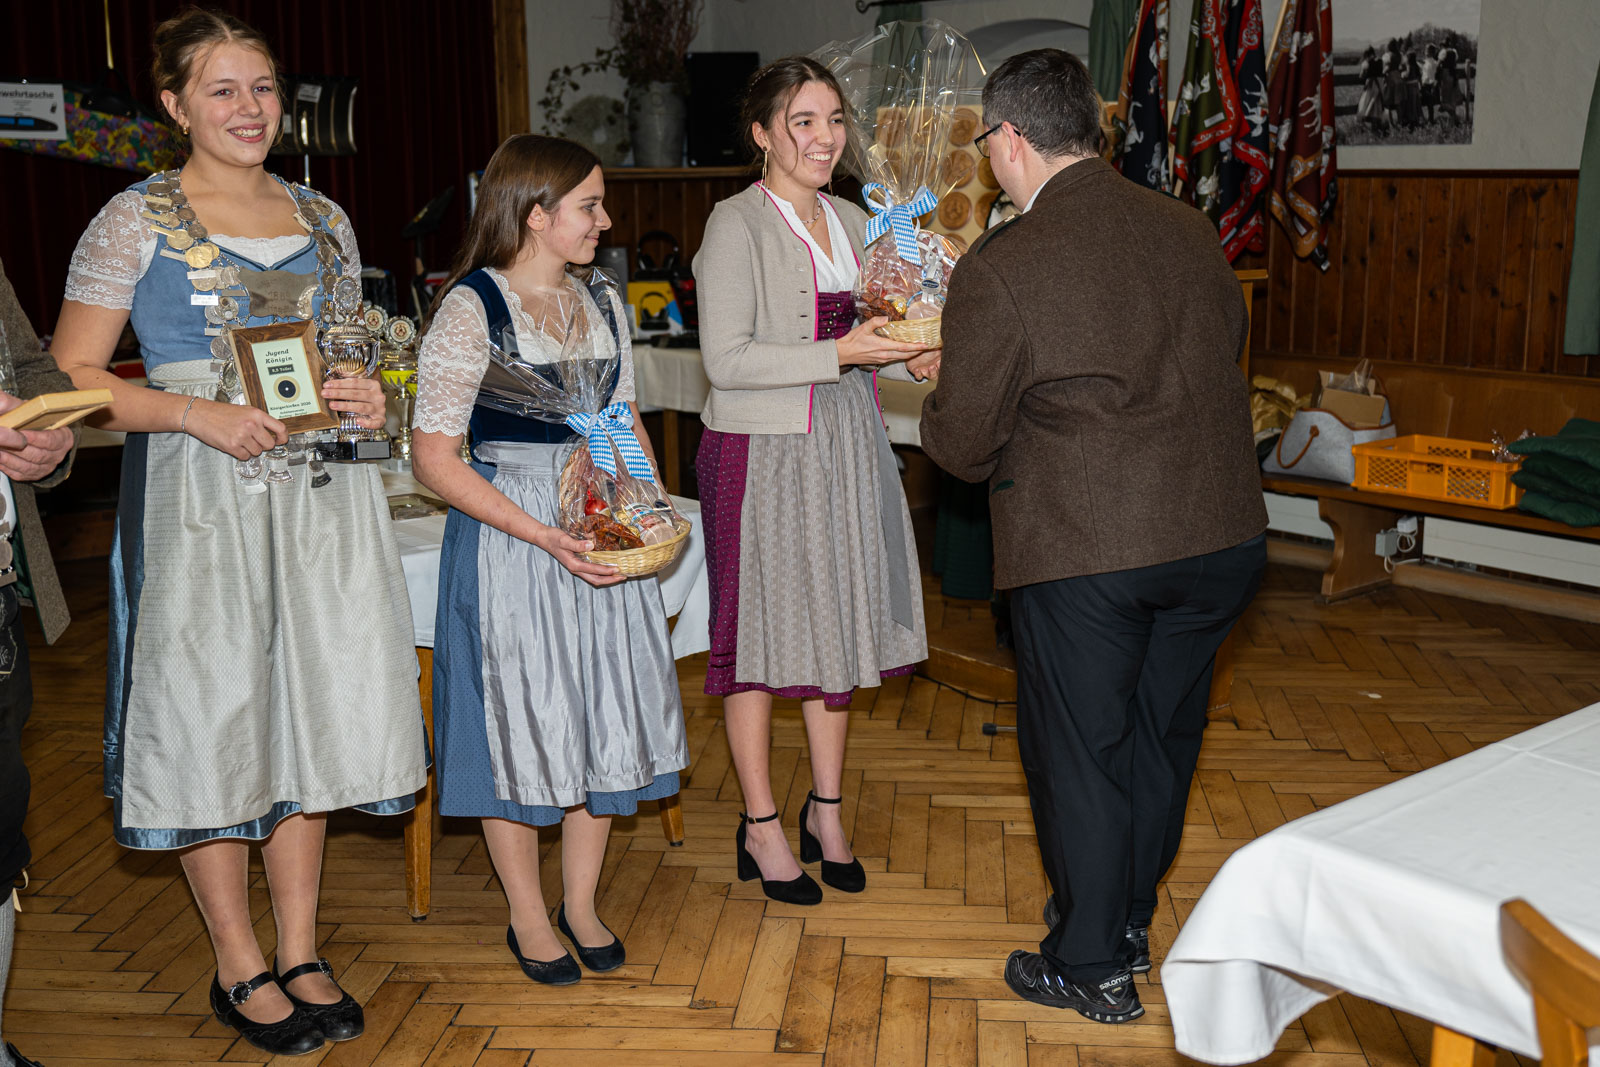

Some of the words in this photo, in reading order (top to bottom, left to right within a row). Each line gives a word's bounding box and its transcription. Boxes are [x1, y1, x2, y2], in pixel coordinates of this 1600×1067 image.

[0, 89, 54, 98] wehrtasche
[266, 349, 289, 357] Jugend
[266, 356, 292, 364] Königin
